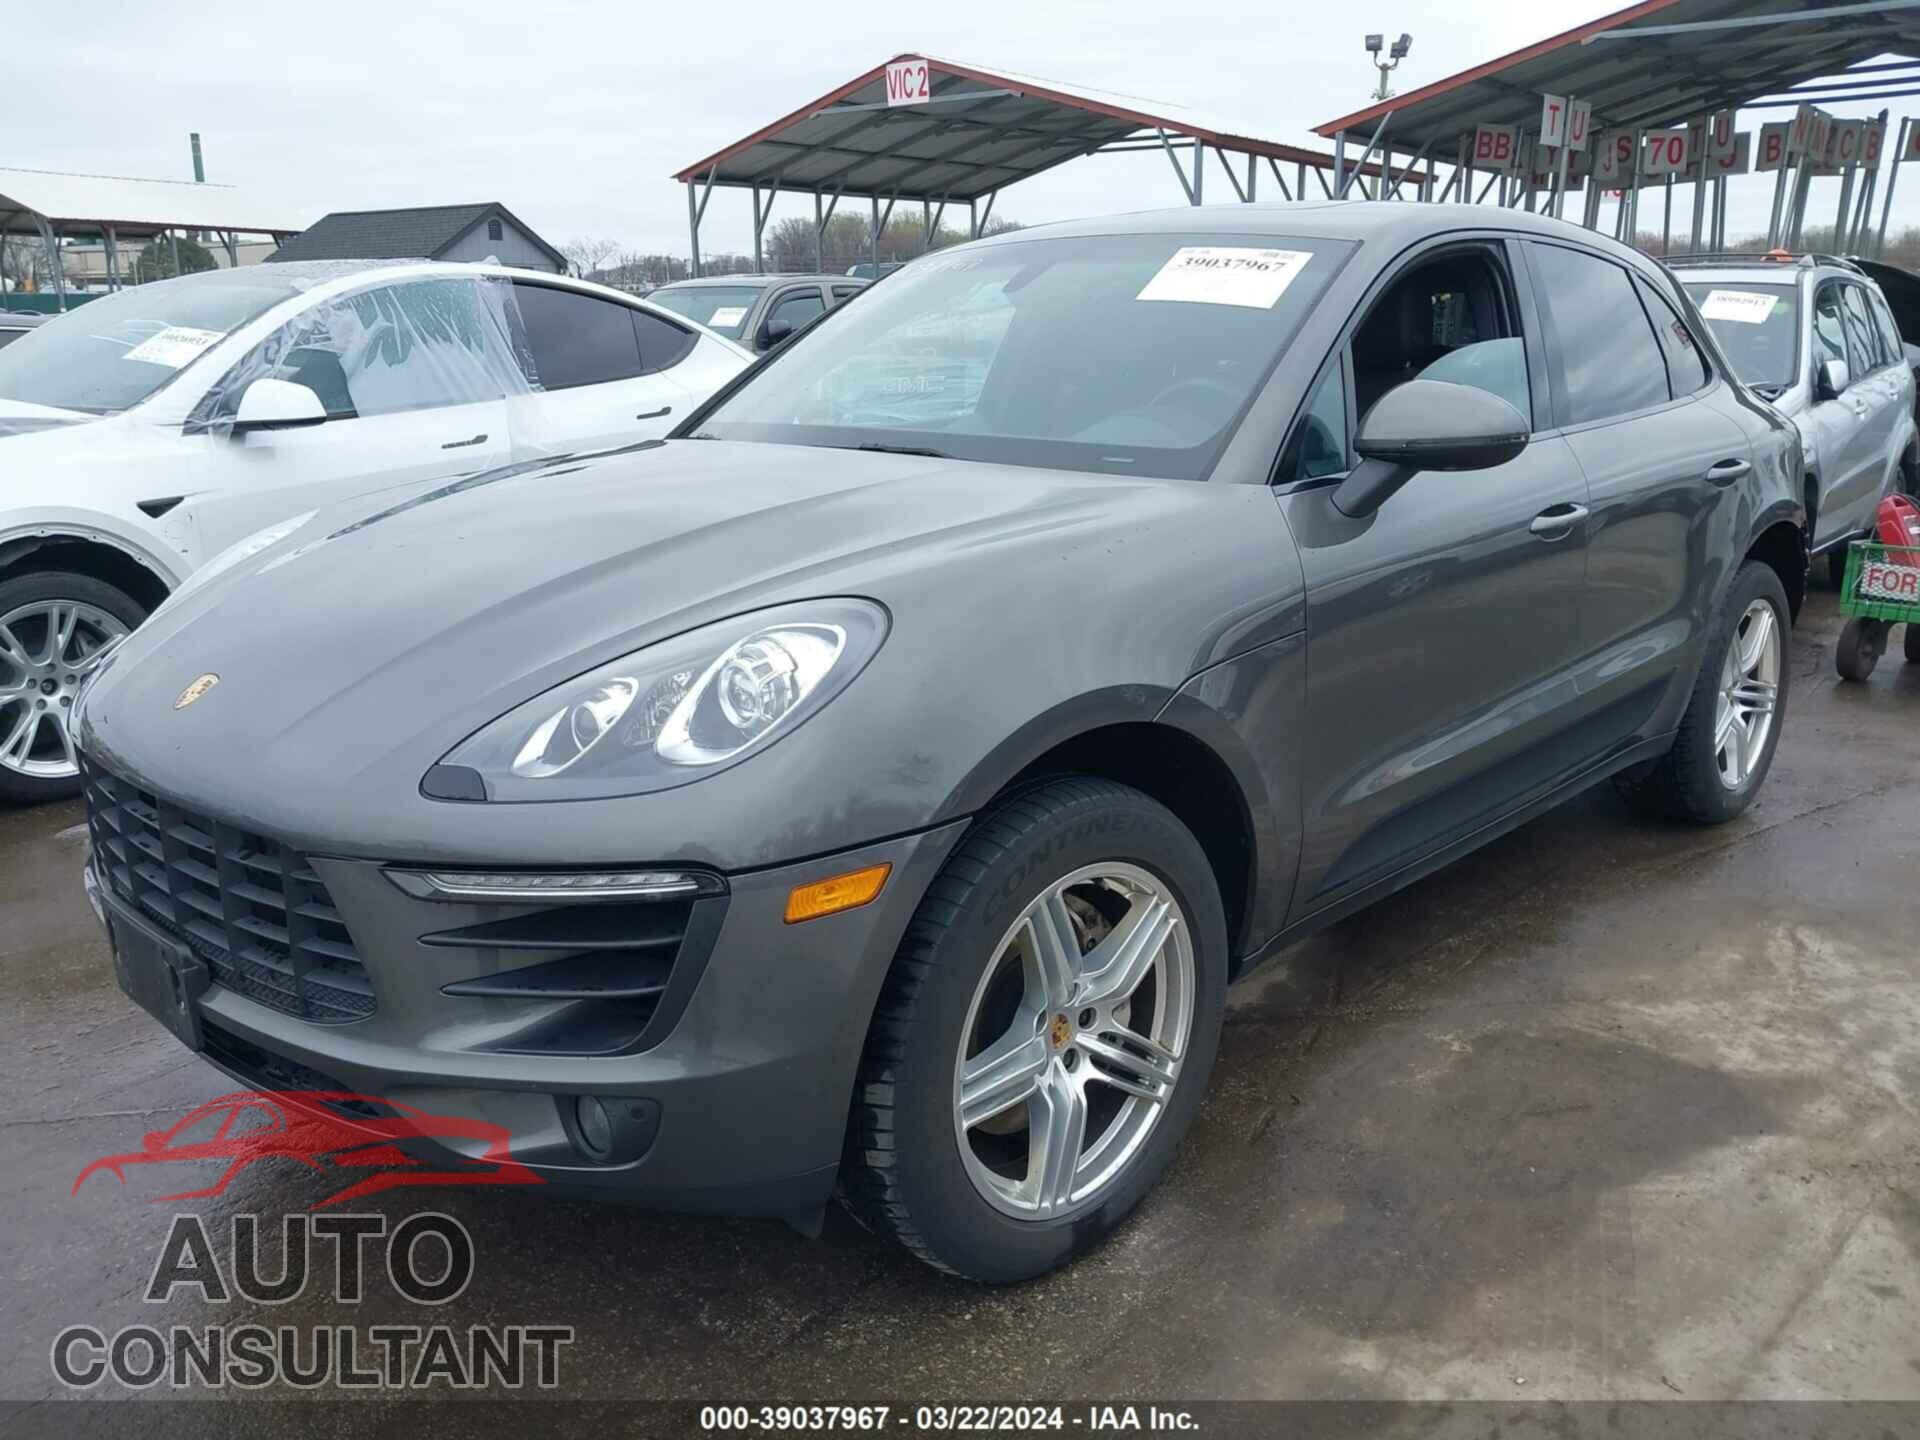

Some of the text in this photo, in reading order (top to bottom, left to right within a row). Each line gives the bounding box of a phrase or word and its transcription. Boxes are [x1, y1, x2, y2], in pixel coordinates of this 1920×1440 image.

[887, 66, 928, 99] VIC 2
[1548, 104, 1561, 137] T
[1572, 111, 1586, 142] U
[1475, 131, 1511, 161] BB
[1649, 135, 1685, 166] 70
[1766, 133, 1782, 162] B
[1179, 256, 1289, 273] 39037967
[1867, 567, 1918, 594] FOR
